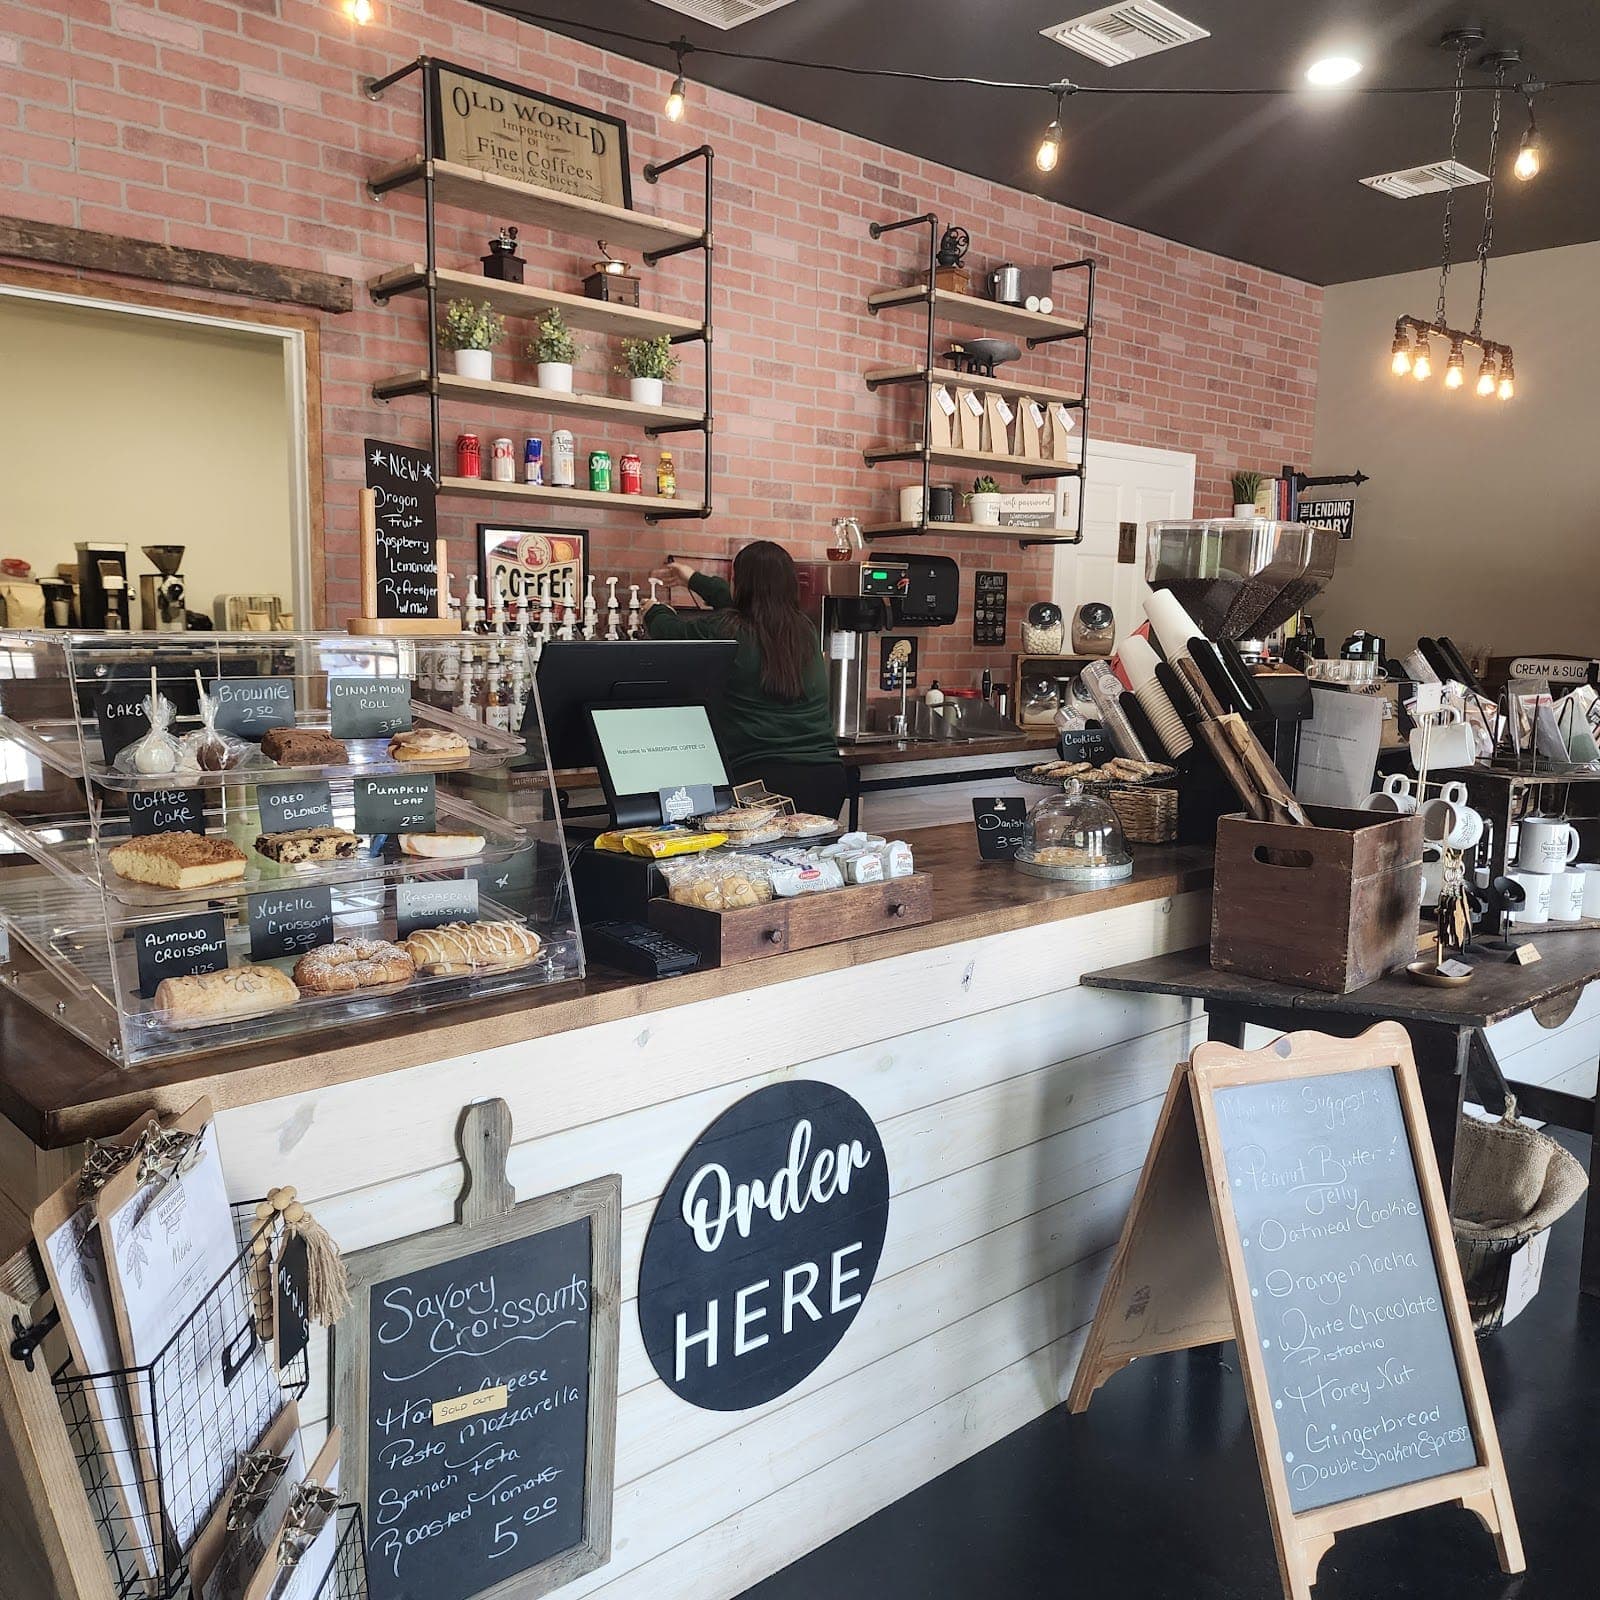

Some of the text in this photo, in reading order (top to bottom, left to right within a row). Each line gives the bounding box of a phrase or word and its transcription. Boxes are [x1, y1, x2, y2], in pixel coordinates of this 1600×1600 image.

[453, 87, 606, 156] OLD WORLD
[502, 118, 561, 142] Importers
[477, 136, 593, 180] Fine Coffees
[492, 157, 524, 175] Teas
[528, 167, 538, 178] &
[540, 169, 579, 188] Spices
[373, 485, 418, 513] Dragon
[1300, 501, 1351, 518] THE LENDING
[381, 514, 423, 529] Fruit
[375, 528, 429, 558] Raspberry
[390, 558, 438, 574] Lemonade
[377, 577, 438, 609] Refresher
[494, 564, 573, 599] COFFEE
[1515, 663, 1590, 678] CREAM & SUGA
[218, 682, 290, 703] Brownie
[335, 683, 406, 697] CINNAMON
[359, 699, 390, 710] ROLL
[106, 703, 144, 719] CAKE
[1064, 733, 1101, 746] Cookies
[132, 790, 189, 811] Coffee
[269, 793, 304, 806] OREO
[283, 803, 329, 820] BLONDIE
[393, 797, 424, 806] LOAF
[153, 806, 196, 827] Cake
[978, 813, 1024, 831] Danish
[255, 898, 316, 920] Nutella
[144, 929, 207, 947] ALMOND
[267, 914, 332, 935] Croissant
[154, 940, 226, 963] CROISSANT
[1232, 1144, 1307, 1191] Peanut
[1292, 1145, 1382, 1190] Butter
[682, 1119, 870, 1251] Order
[1305, 1185, 1359, 1215] Jelly
[1258, 1198, 1420, 1251] Oatmeal Cookie
[1265, 1269, 1348, 1306] Orange
[279, 1266, 308, 1340] MENUS
[378, 1276, 496, 1344] Savory
[430, 1273, 588, 1353] Croissants
[675, 1241, 863, 1382] HERE
[1278, 1295, 1439, 1351] White Chocolate
[1282, 1337, 1386, 1366] Pistachio
[1284, 1356, 1416, 1414] Honey Nut
[376, 1398, 432, 1435] Ha
[441, 1394, 495, 1417] SOLD OUT
[1305, 1405, 1440, 1456] Gingerbread
[378, 1438, 446, 1471] Pesto
[1291, 1458, 1359, 1491] Double
[1361, 1441, 1418, 1473] Shaken
[376, 1442, 521, 1525] Spinach Feta
[370, 1505, 472, 1578] Roasted
